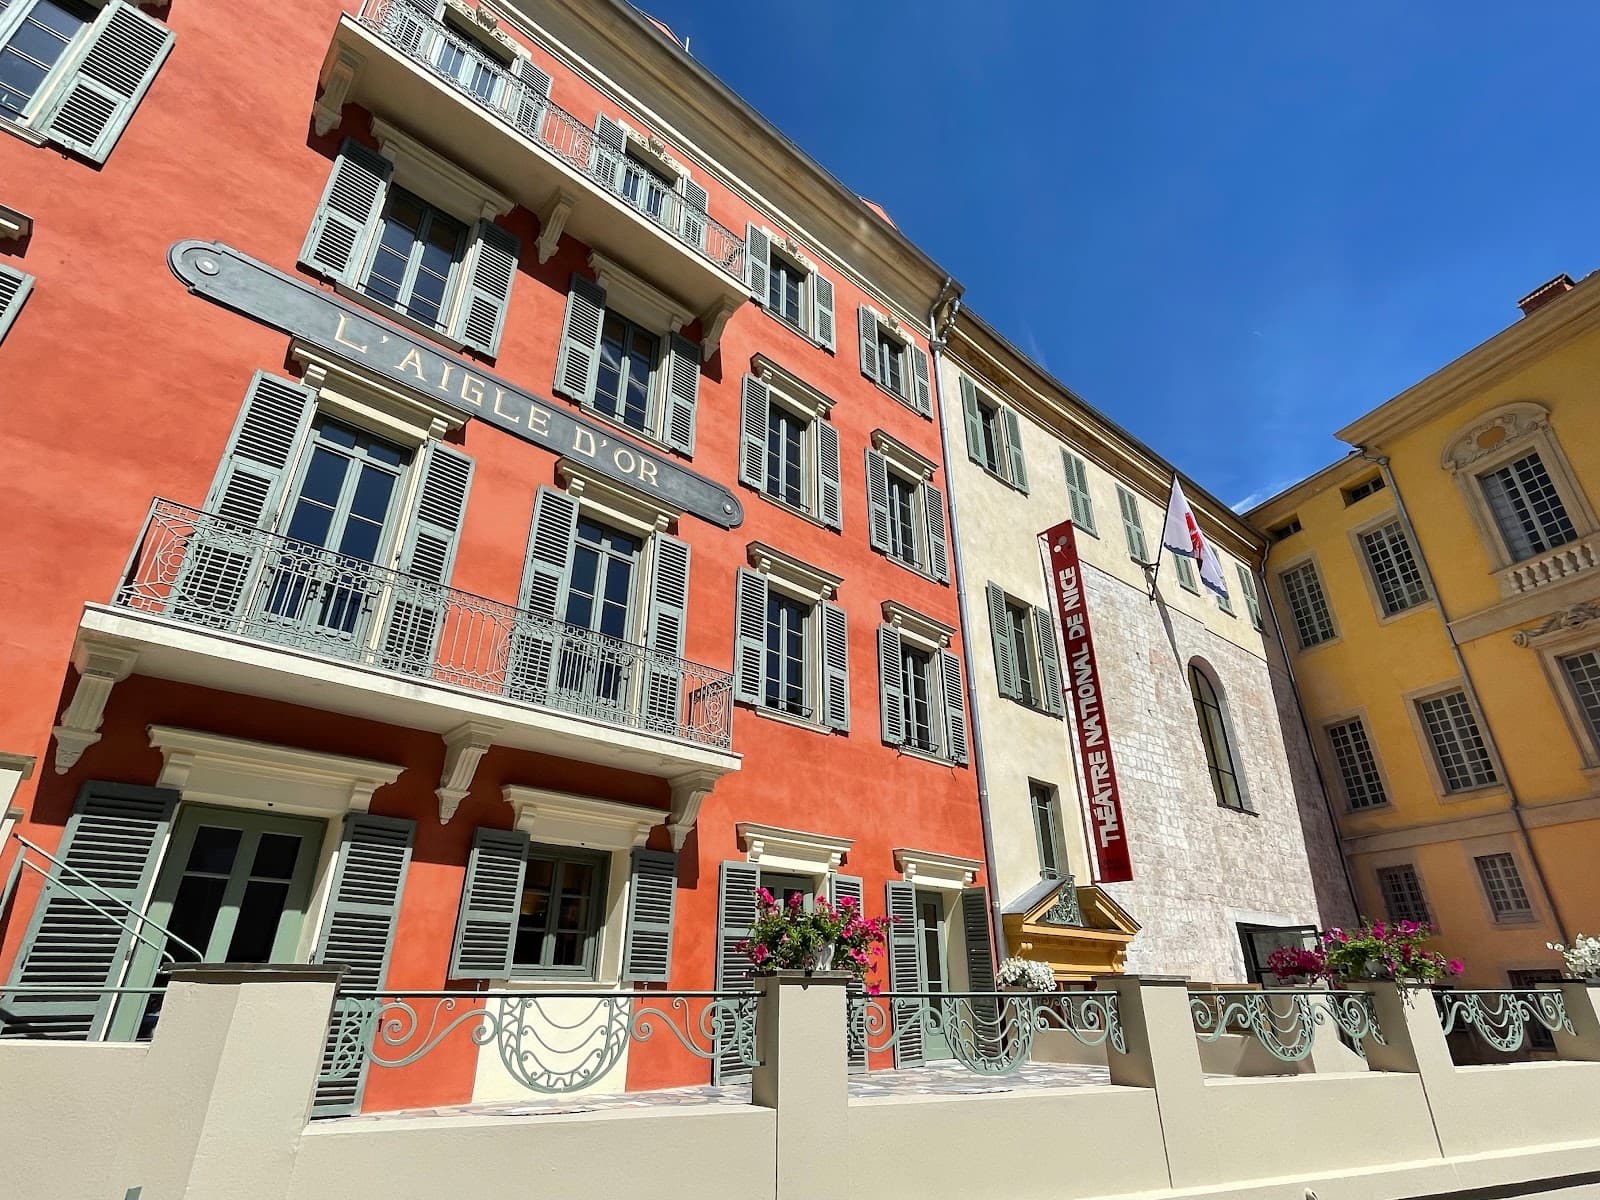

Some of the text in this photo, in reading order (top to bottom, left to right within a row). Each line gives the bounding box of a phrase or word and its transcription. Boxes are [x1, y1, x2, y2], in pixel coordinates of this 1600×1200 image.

[334, 312, 659, 487] L'AIGLE D'OR
[1059, 566, 1081, 612] NICE
[1066, 612, 1086, 641] DE
[1072, 642, 1105, 747] NATIONAL
[1088, 750, 1121, 848] THÉÂTRE
